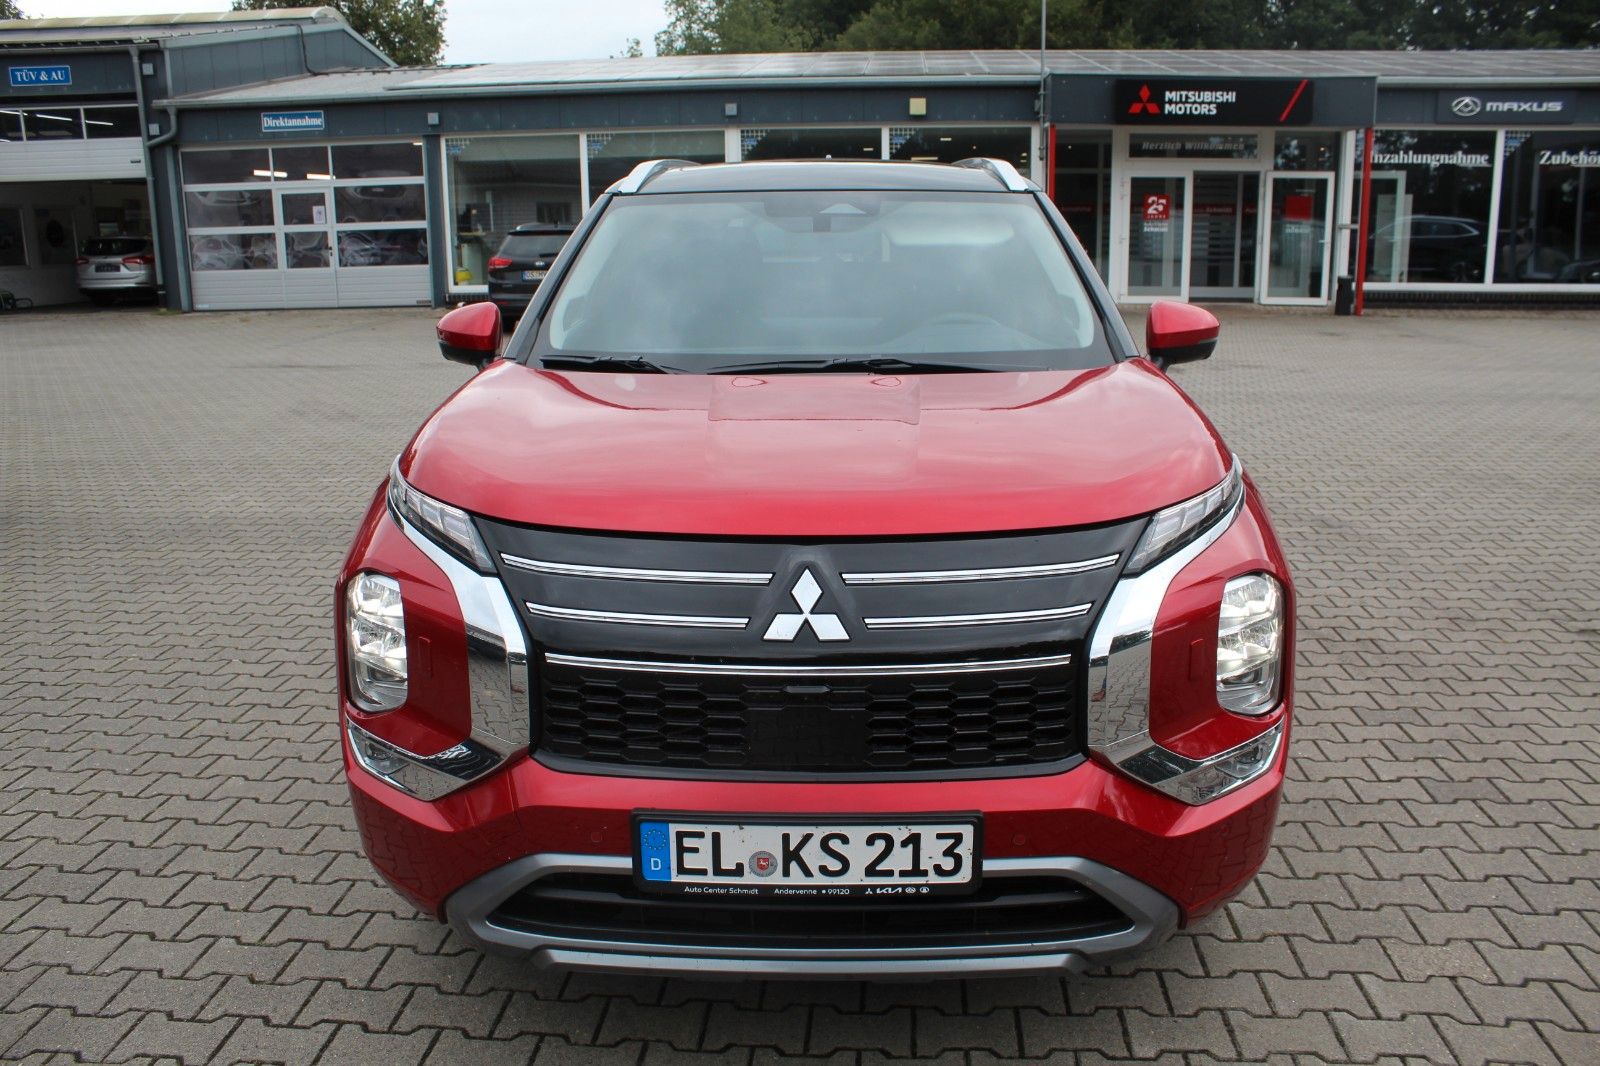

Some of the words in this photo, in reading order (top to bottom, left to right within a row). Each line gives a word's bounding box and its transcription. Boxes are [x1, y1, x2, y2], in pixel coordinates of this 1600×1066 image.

[15, 69, 37, 81] TÜV
[40, 71, 49, 81] &
[51, 70, 66, 81] AU
[1164, 91, 1237, 103] MITSUBISHI
[1164, 103, 1218, 115] MOTORS
[1485, 101, 1563, 112] MAXUS
[263, 116, 322, 128] Direktannahme
[1142, 141, 1182, 151] Herzlich
[1147, 196, 1167, 214] 25
[675, 830, 745, 877] EL
[781, 832, 851, 878] KS
[864, 832, 964, 878] 213
[650, 857, 662, 871] D
[684, 886, 703, 894] Auto
[703, 886, 728, 895] Center
[729, 887, 759, 895] Schmidt
[774, 887, 818, 895] Andervenne
